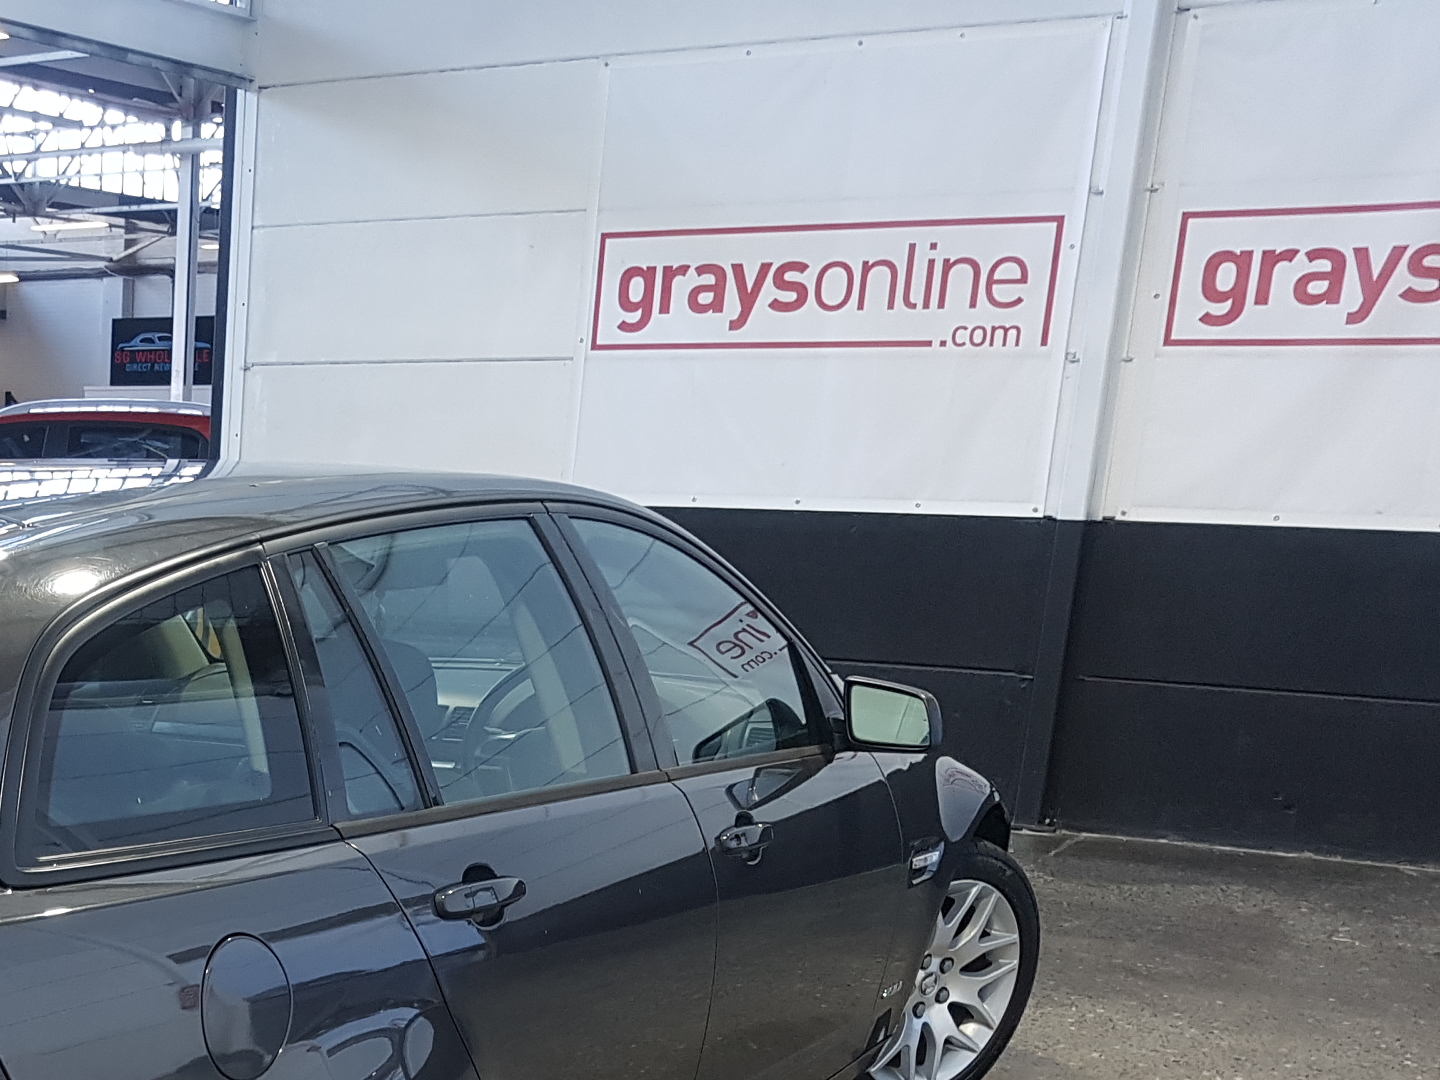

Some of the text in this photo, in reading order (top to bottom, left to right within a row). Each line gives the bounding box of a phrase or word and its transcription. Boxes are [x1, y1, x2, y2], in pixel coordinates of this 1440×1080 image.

[617, 241, 1029, 334] graysonline
[939, 323, 1022, 348] .com
[114, 348, 210, 364] SG WHOLLE
[125, 363, 152, 372] DIRECT
